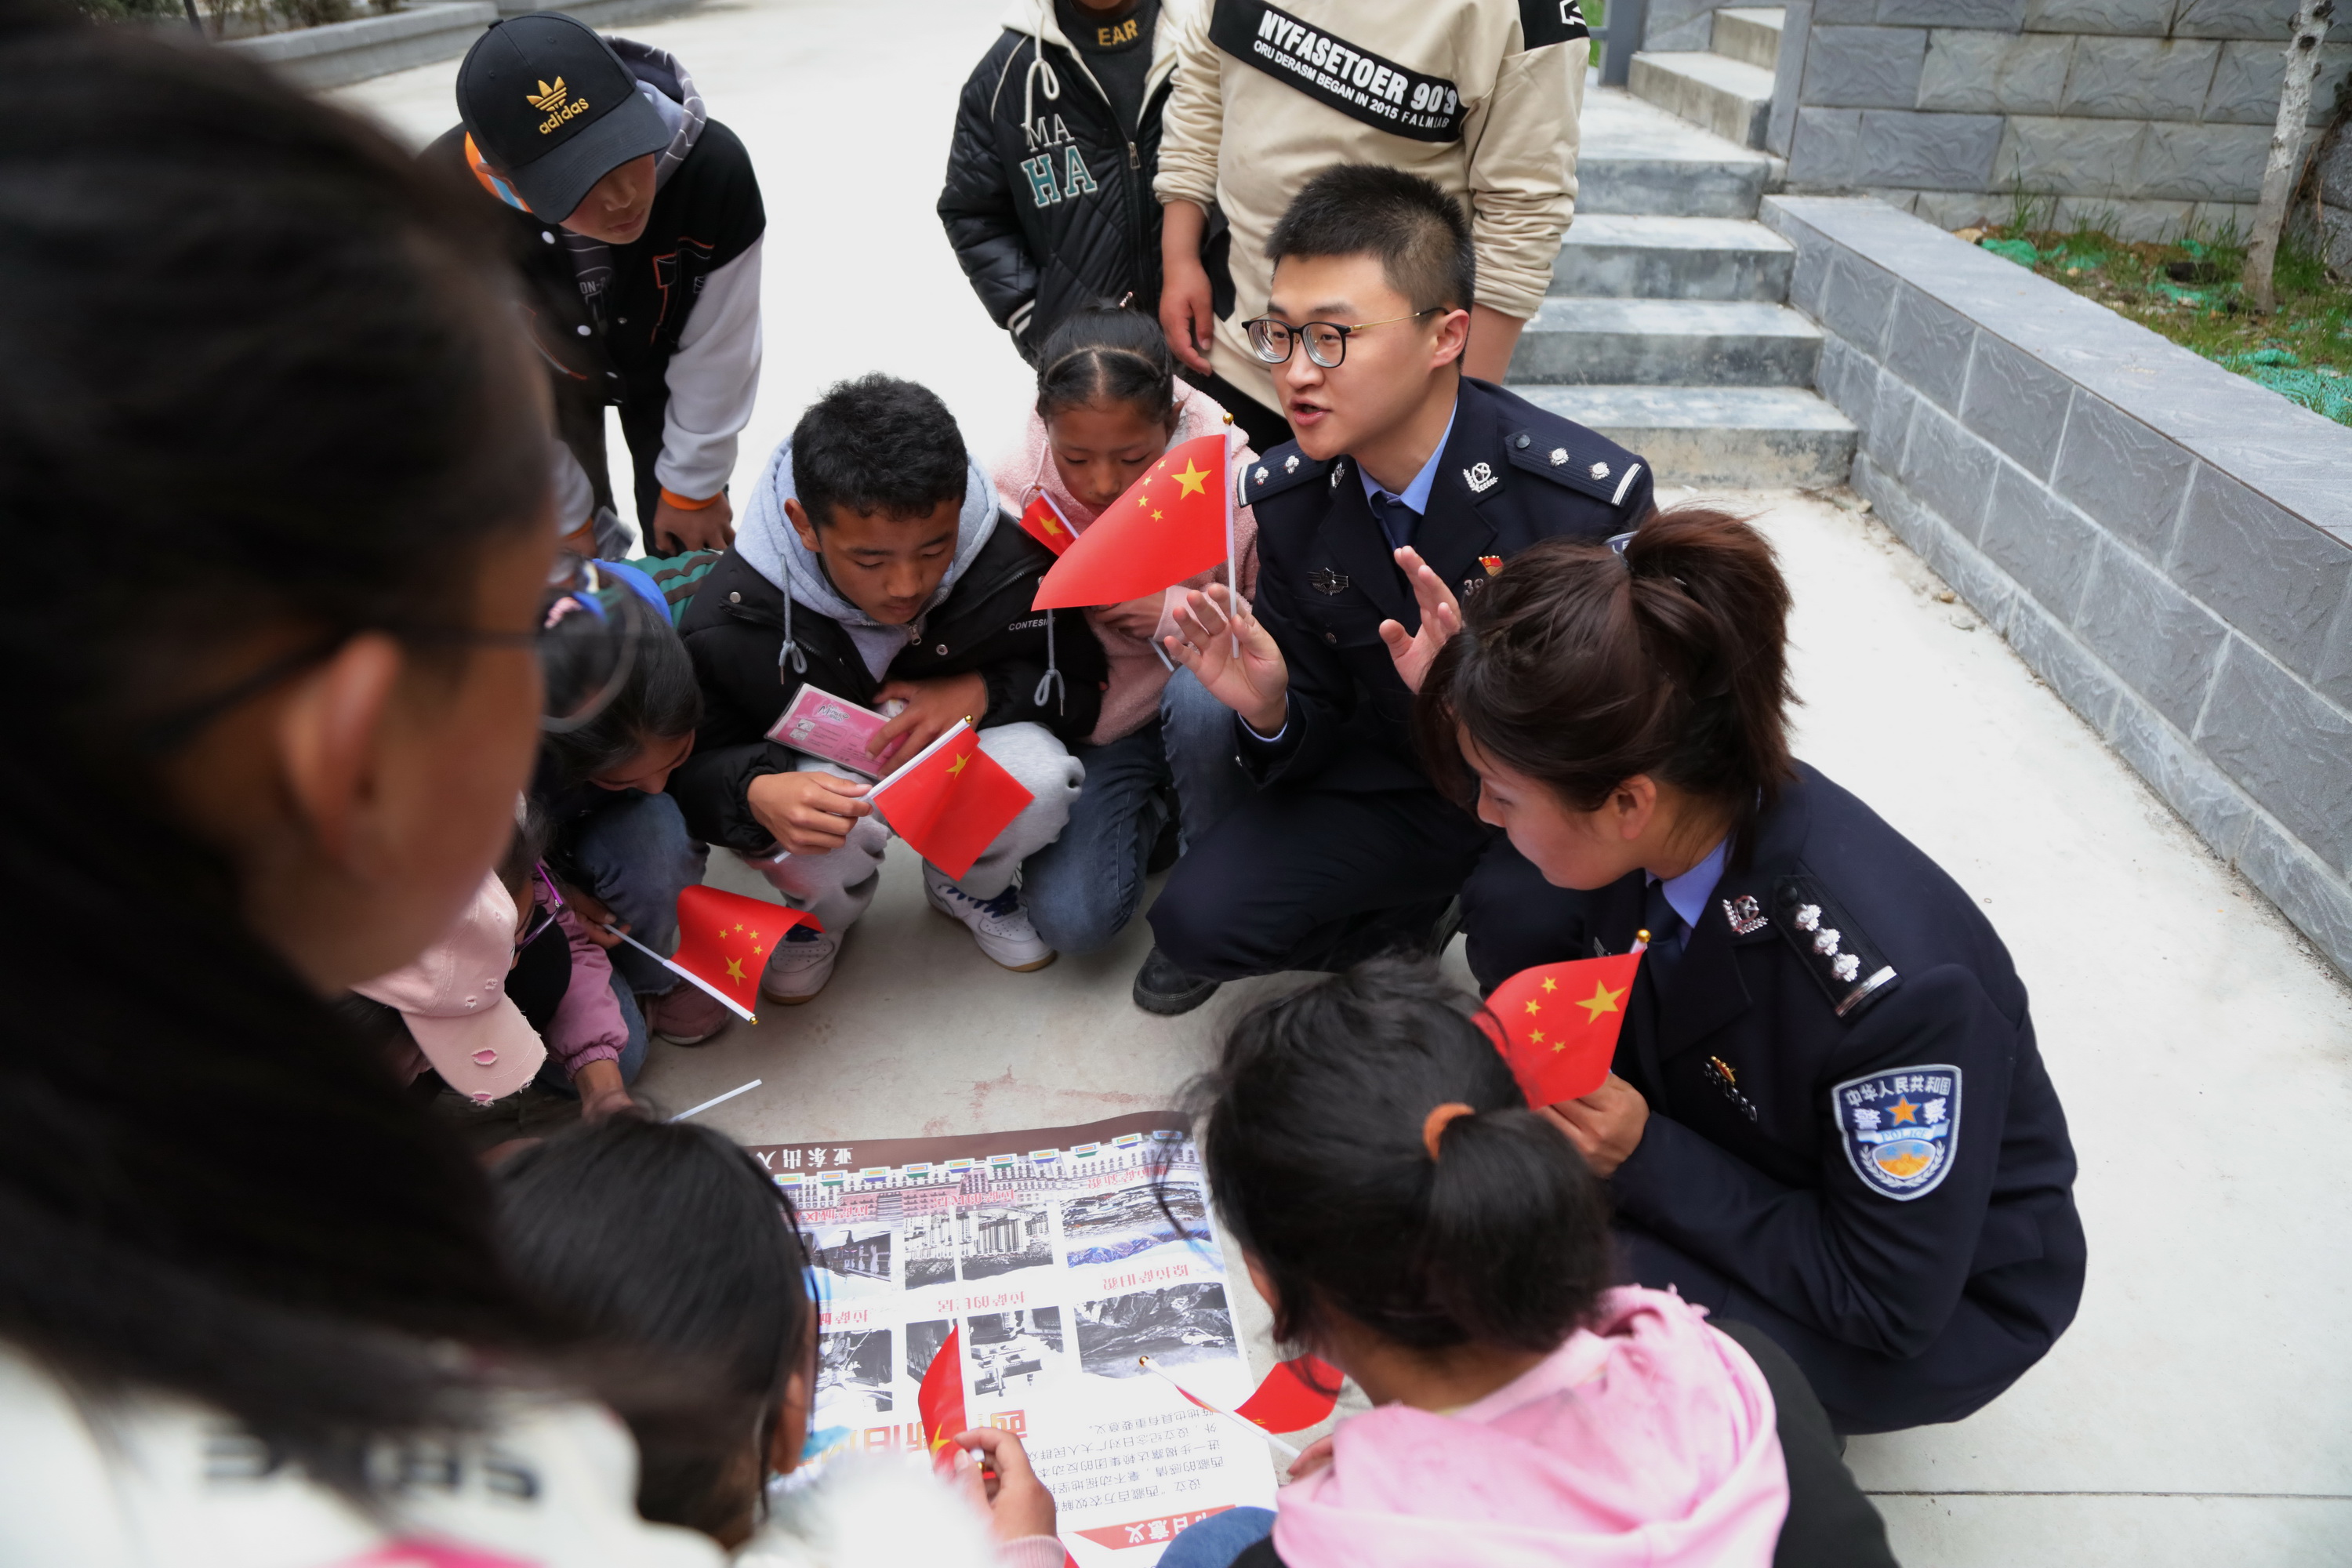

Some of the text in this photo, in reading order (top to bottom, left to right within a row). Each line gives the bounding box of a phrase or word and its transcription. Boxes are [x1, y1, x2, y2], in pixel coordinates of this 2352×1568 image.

[1098, 19, 1138, 47] EAR
[1258, 9, 1409, 105] NYFASETOER
[1254, 39, 1276, 60] ORU
[1275, 49, 1316, 81] DERASM
[1316, 71, 1355, 100] BEGAN
[1355, 91, 1370, 107] IN
[1369, 99, 1399, 120] 2015
[539, 97, 590, 135] adidas
[1021, 113, 1075, 153] MA
[1020, 144, 1098, 208] HA
[1845, 1075, 1952, 1107] 中华人民共和国
[1881, 1128, 1929, 1142] POLICE
[1032, 1439, 1221, 1479] 进一步揭露达赖集团的反动本
